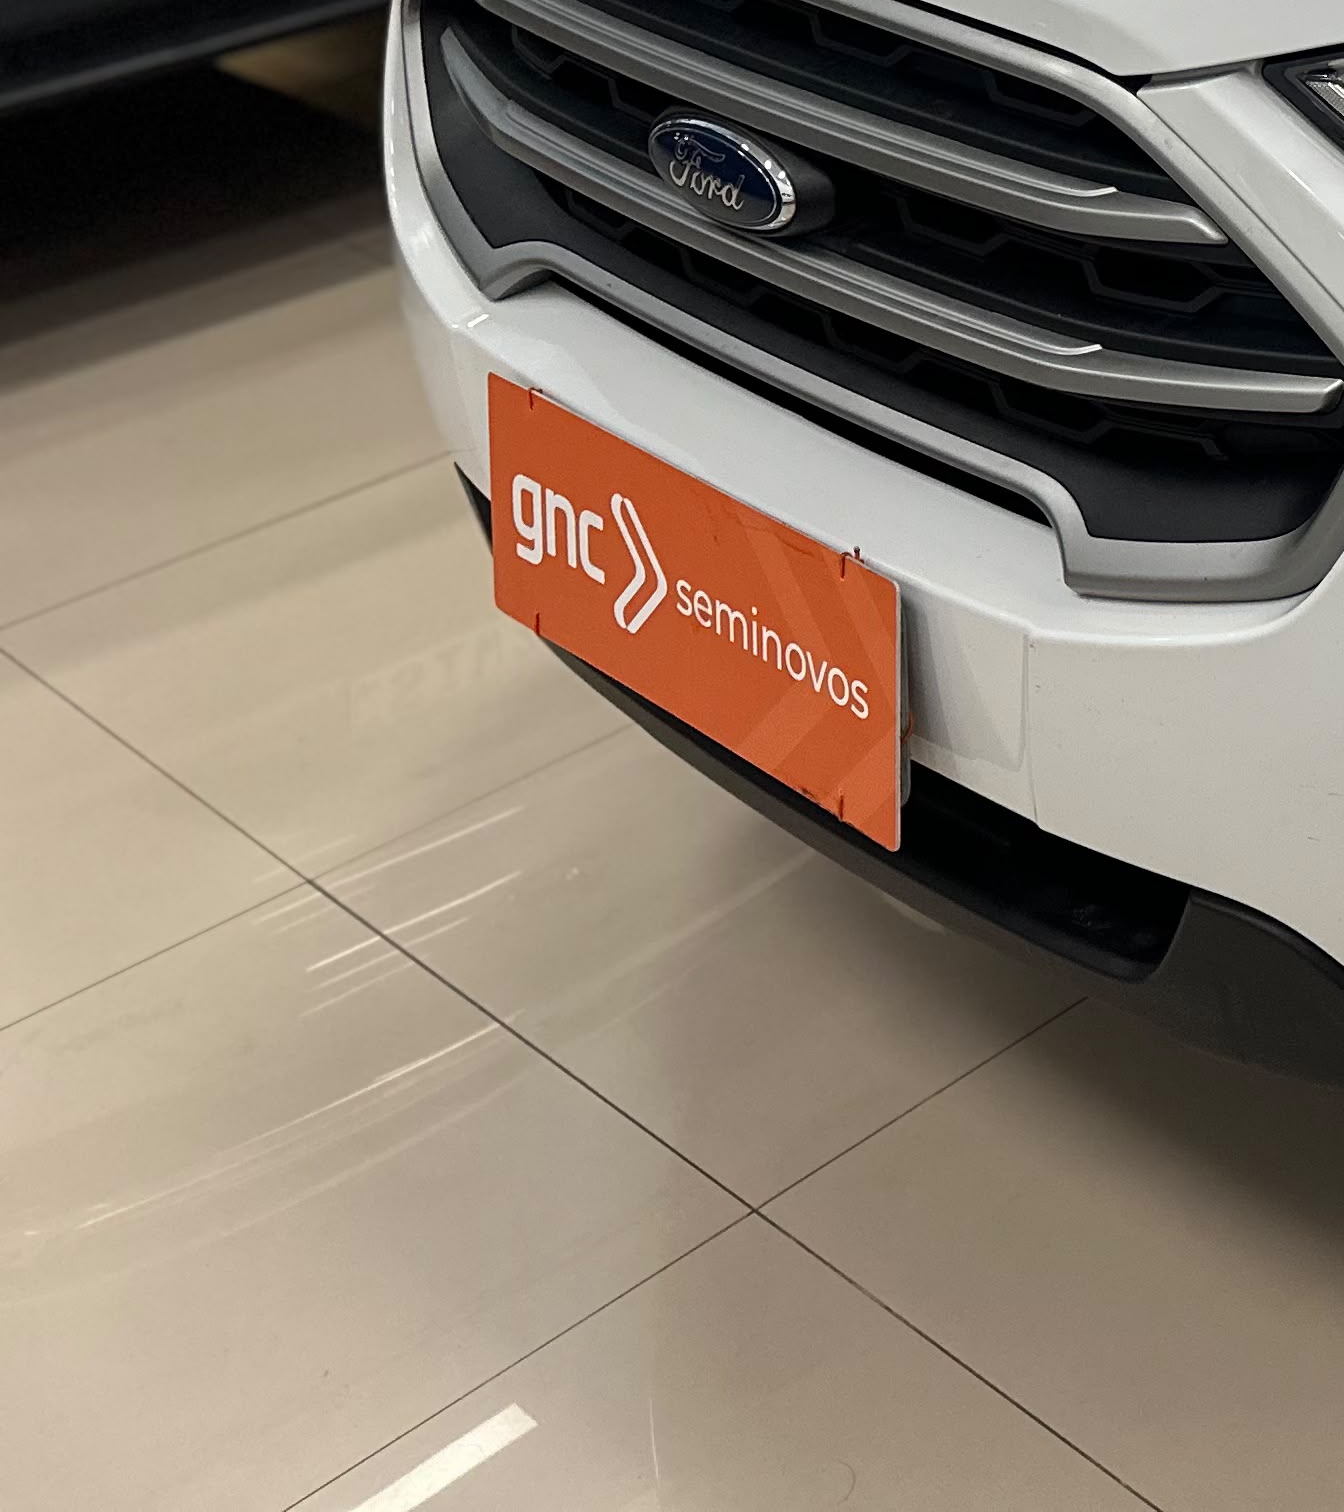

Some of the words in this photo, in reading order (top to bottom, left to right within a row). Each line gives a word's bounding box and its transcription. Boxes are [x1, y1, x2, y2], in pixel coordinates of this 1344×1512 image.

[669, 134, 746, 210] Ford
[511, 473, 606, 585] gnc
[675, 578, 870, 720] seminovos
